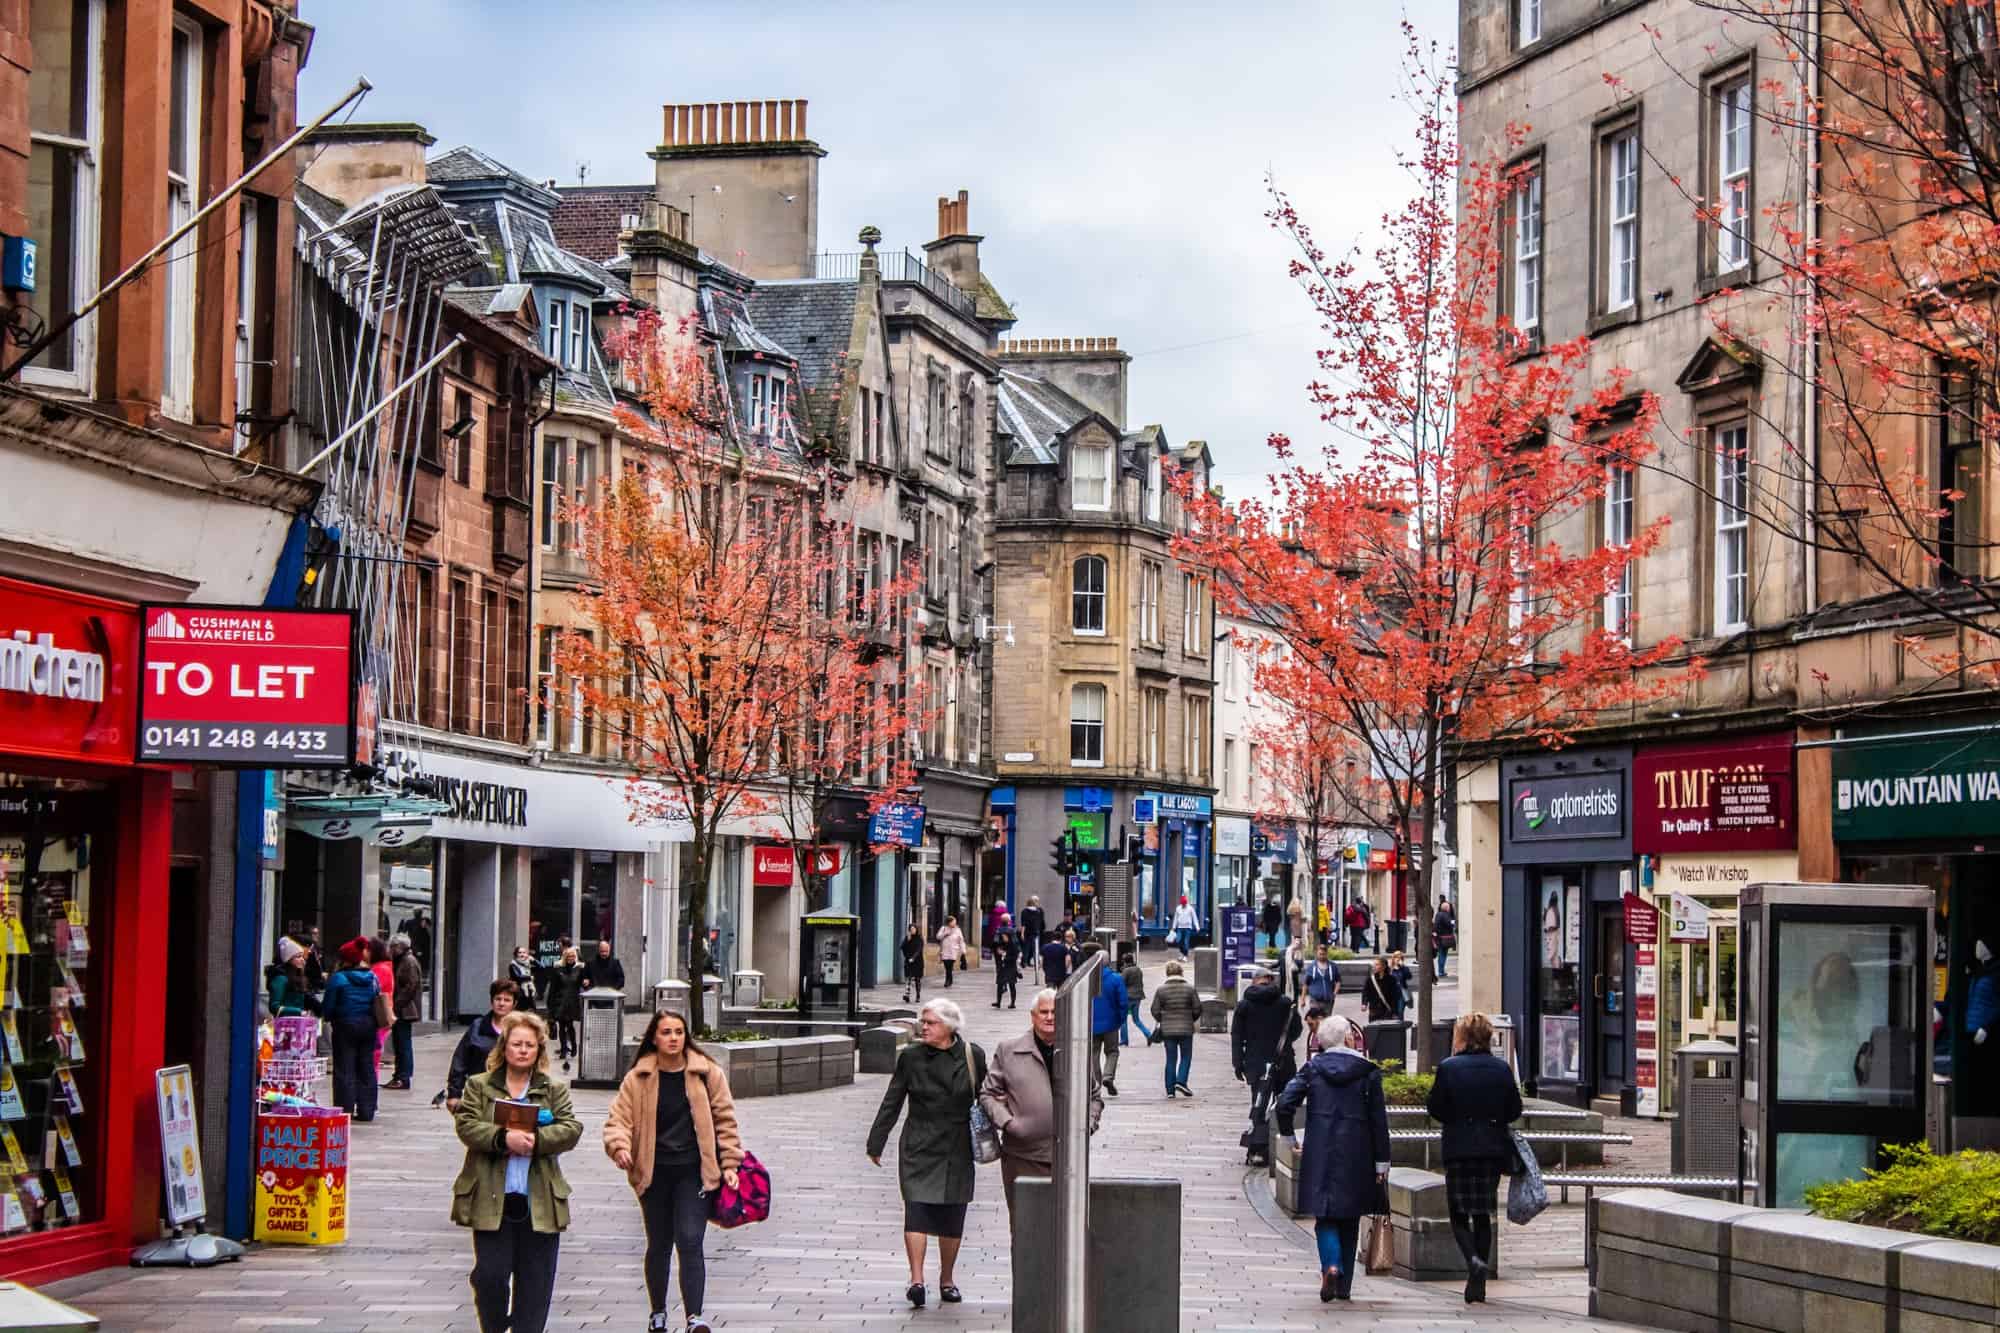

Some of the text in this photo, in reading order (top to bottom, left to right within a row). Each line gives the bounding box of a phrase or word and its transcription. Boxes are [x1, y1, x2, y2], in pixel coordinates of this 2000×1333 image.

[190, 617, 274, 631] CUSHMAN &
[189, 629, 275, 642] WAKEFIELD
[147, 661, 315, 699] TO LET
[145, 726, 327, 750] 0141 248 4433
[1721, 784, 1770, 795] KEY CUTTING
[1853, 771, 2000, 808] MOUNTAIN WA
[471, 780, 528, 827] SPENCER
[1550, 787, 1617, 825] optometrists
[1720, 794, 1771, 806] SHOE REPAIRS
[1724, 804, 1768, 815] ENGRAVING
[1661, 819, 1675, 833] The
[1675, 818, 1702, 835] Quality
[1716, 816, 1744, 827] WATCH
[1744, 815, 1776, 826] REPAIRS
[1678, 865, 1705, 882] Watch
[1705, 864, 1750, 883] Wrkshop
[263, 1125, 319, 1148] HALF
[260, 1146, 321, 1170] PRICE
[268, 1207, 309, 1219] GIFTS &
[266, 1220, 309, 1233] GAMES!
